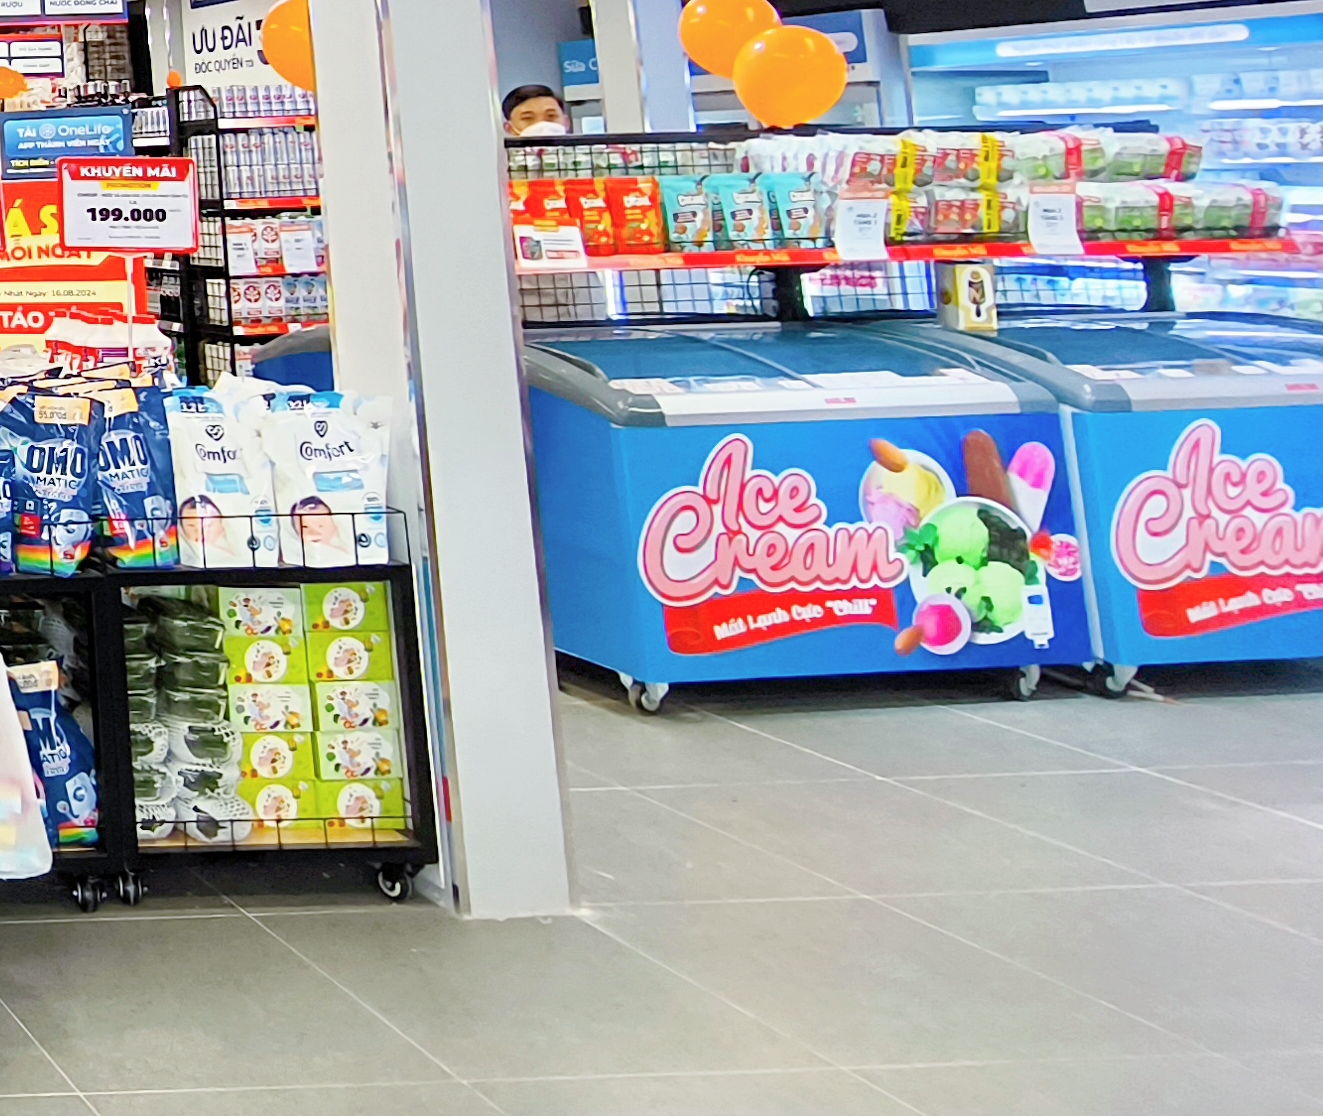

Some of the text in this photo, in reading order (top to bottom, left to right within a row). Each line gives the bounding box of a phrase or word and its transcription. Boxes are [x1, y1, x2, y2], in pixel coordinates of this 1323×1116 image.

[220, 15, 252, 50] ĐÃI
[80, 163, 177, 177] KHUYẾN MÃI
[86, 208, 167, 222] 199.000
[25, 445, 87, 479] OMO
[98, 435, 149, 472] OMO
[299, 440, 356, 461] Comfort
[36, 476, 78, 489] MATIC
[109, 468, 149, 482] MATIC
[702, 437, 823, 534] Ice
[1172, 422, 1290, 518] Ice
[642, 489, 905, 602] Cream
